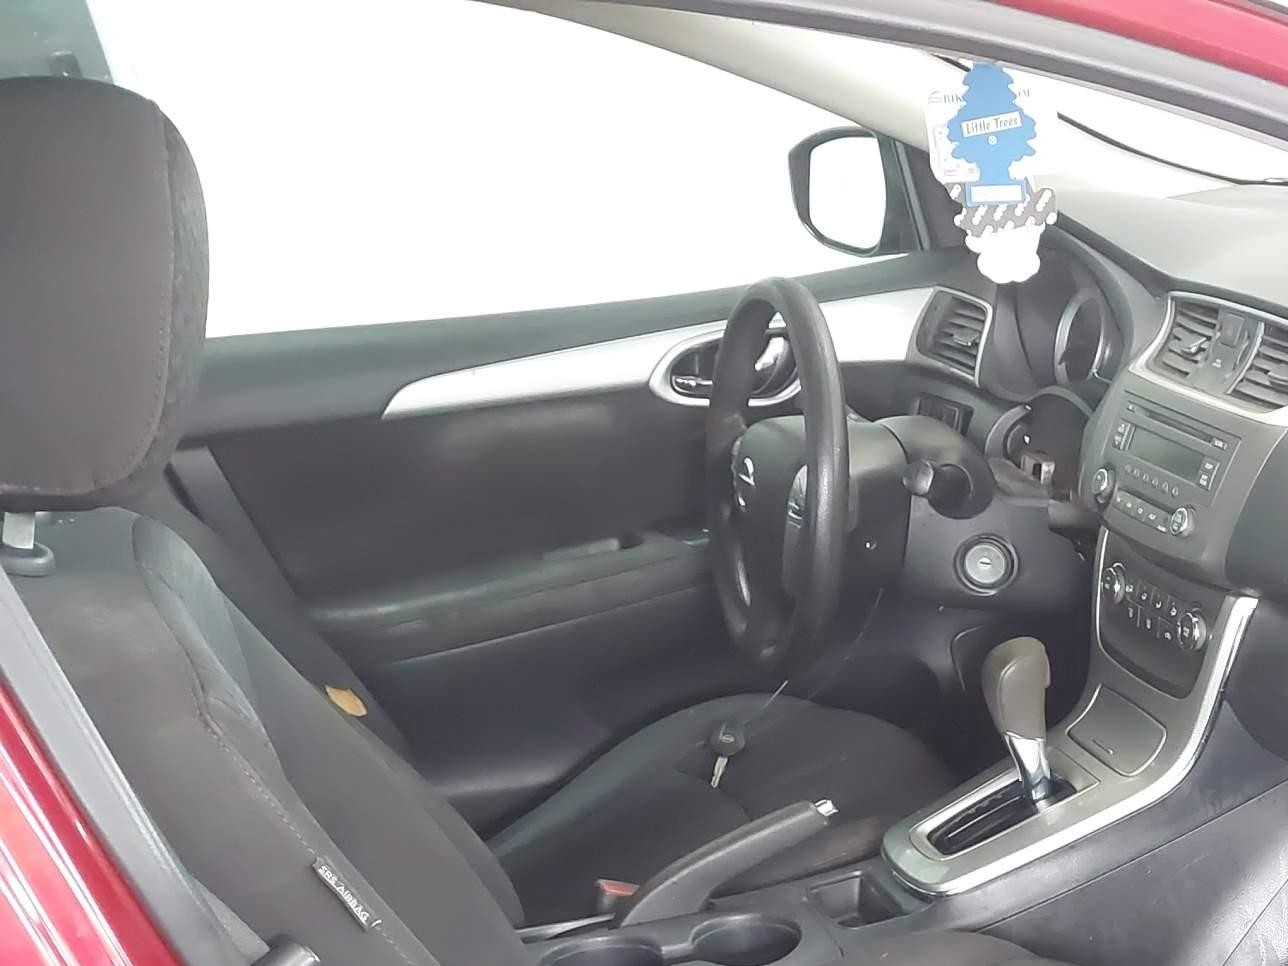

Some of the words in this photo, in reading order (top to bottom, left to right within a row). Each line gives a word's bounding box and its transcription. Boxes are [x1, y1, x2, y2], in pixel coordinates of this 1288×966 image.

[966, 119, 991, 134] Little
[993, 116, 1018, 129] Trees
[337, 884, 369, 922] AIRBAG
